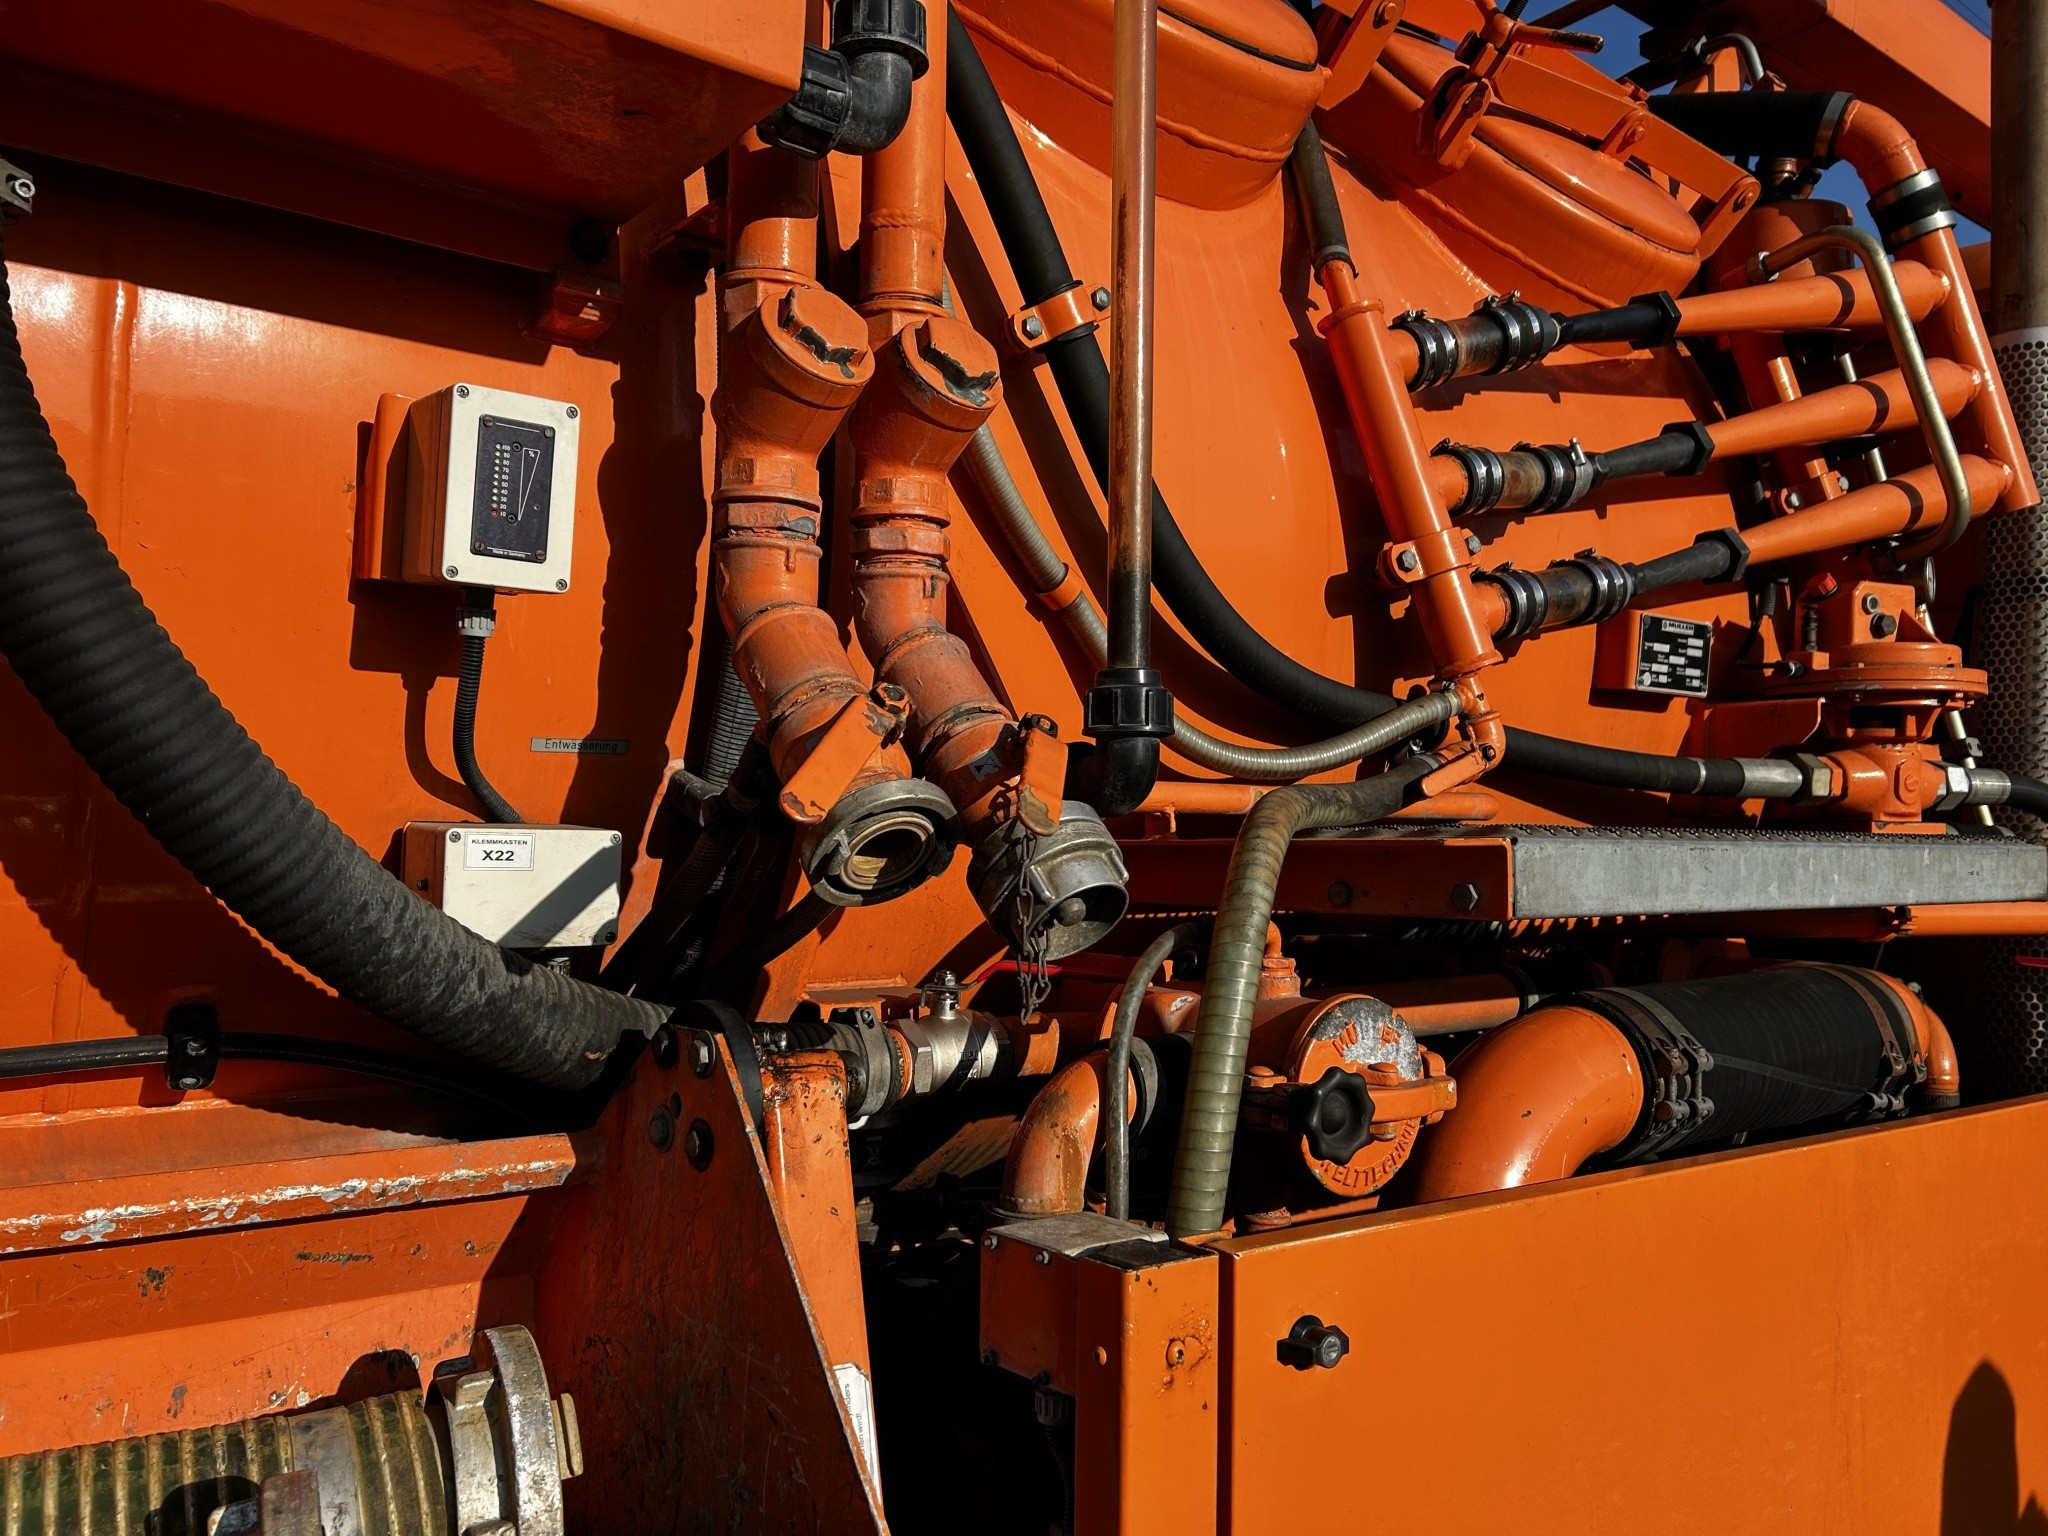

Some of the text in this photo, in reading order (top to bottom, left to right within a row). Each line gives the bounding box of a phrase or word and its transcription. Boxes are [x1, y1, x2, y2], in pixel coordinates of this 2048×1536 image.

[544, 738, 618, 752] Entwässerung
[471, 838, 528, 846] KLEMMKASTEN
[481, 849, 515, 862] X22
